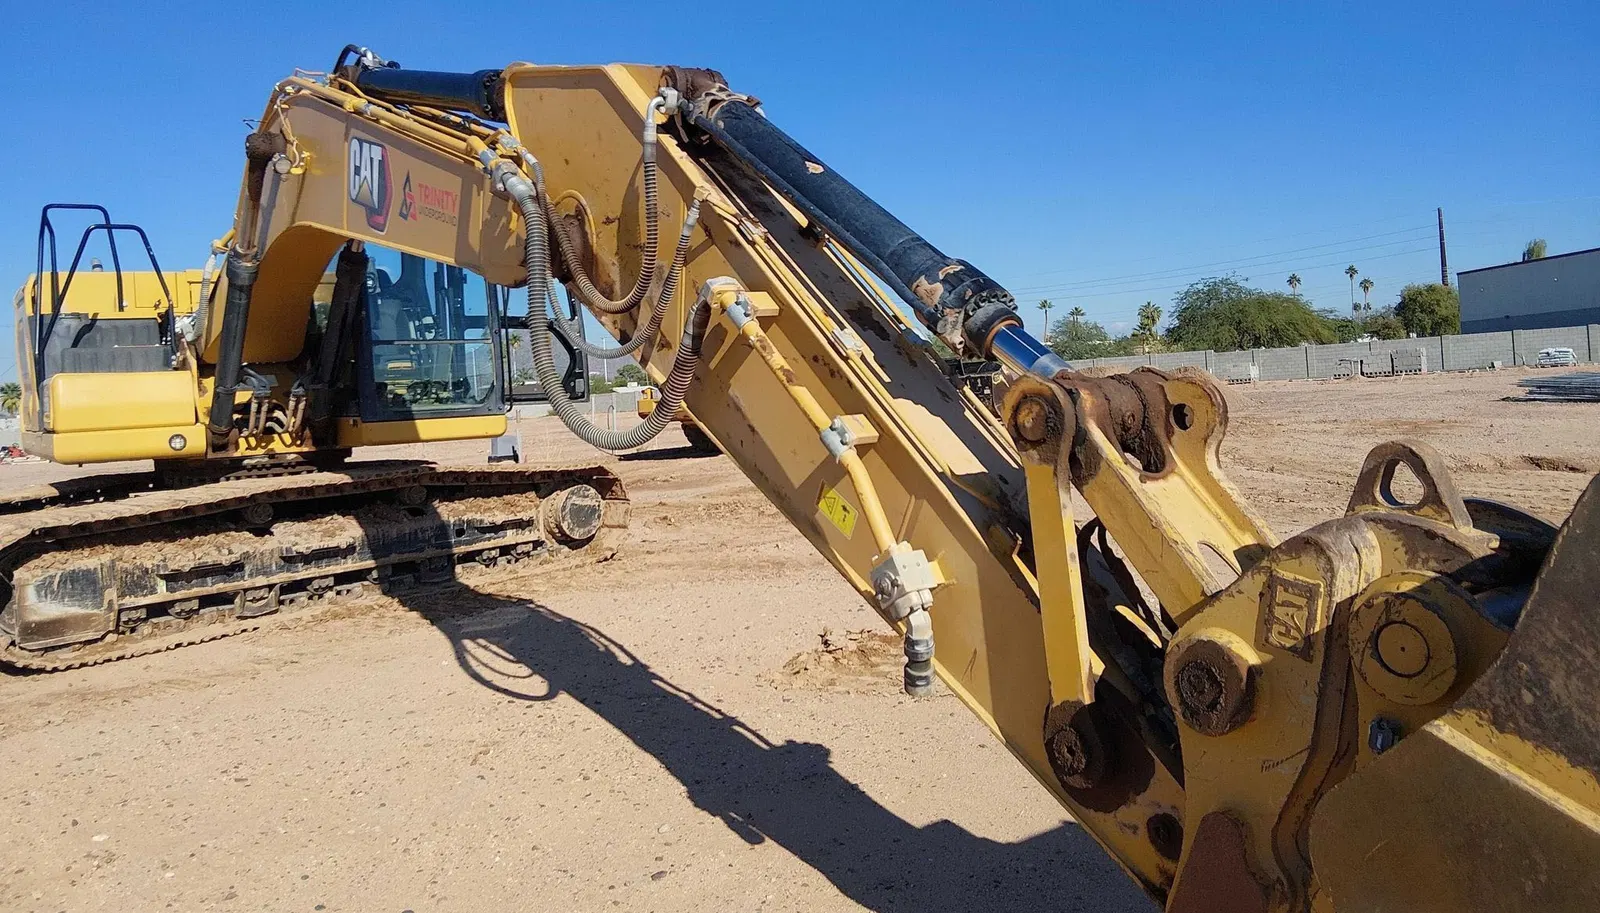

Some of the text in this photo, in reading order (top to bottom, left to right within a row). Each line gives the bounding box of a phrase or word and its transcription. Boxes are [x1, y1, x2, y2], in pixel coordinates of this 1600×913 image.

[350, 138, 382, 208] CAT
[418, 182, 458, 213] TRINITY
[1271, 585, 1308, 650] CAT
